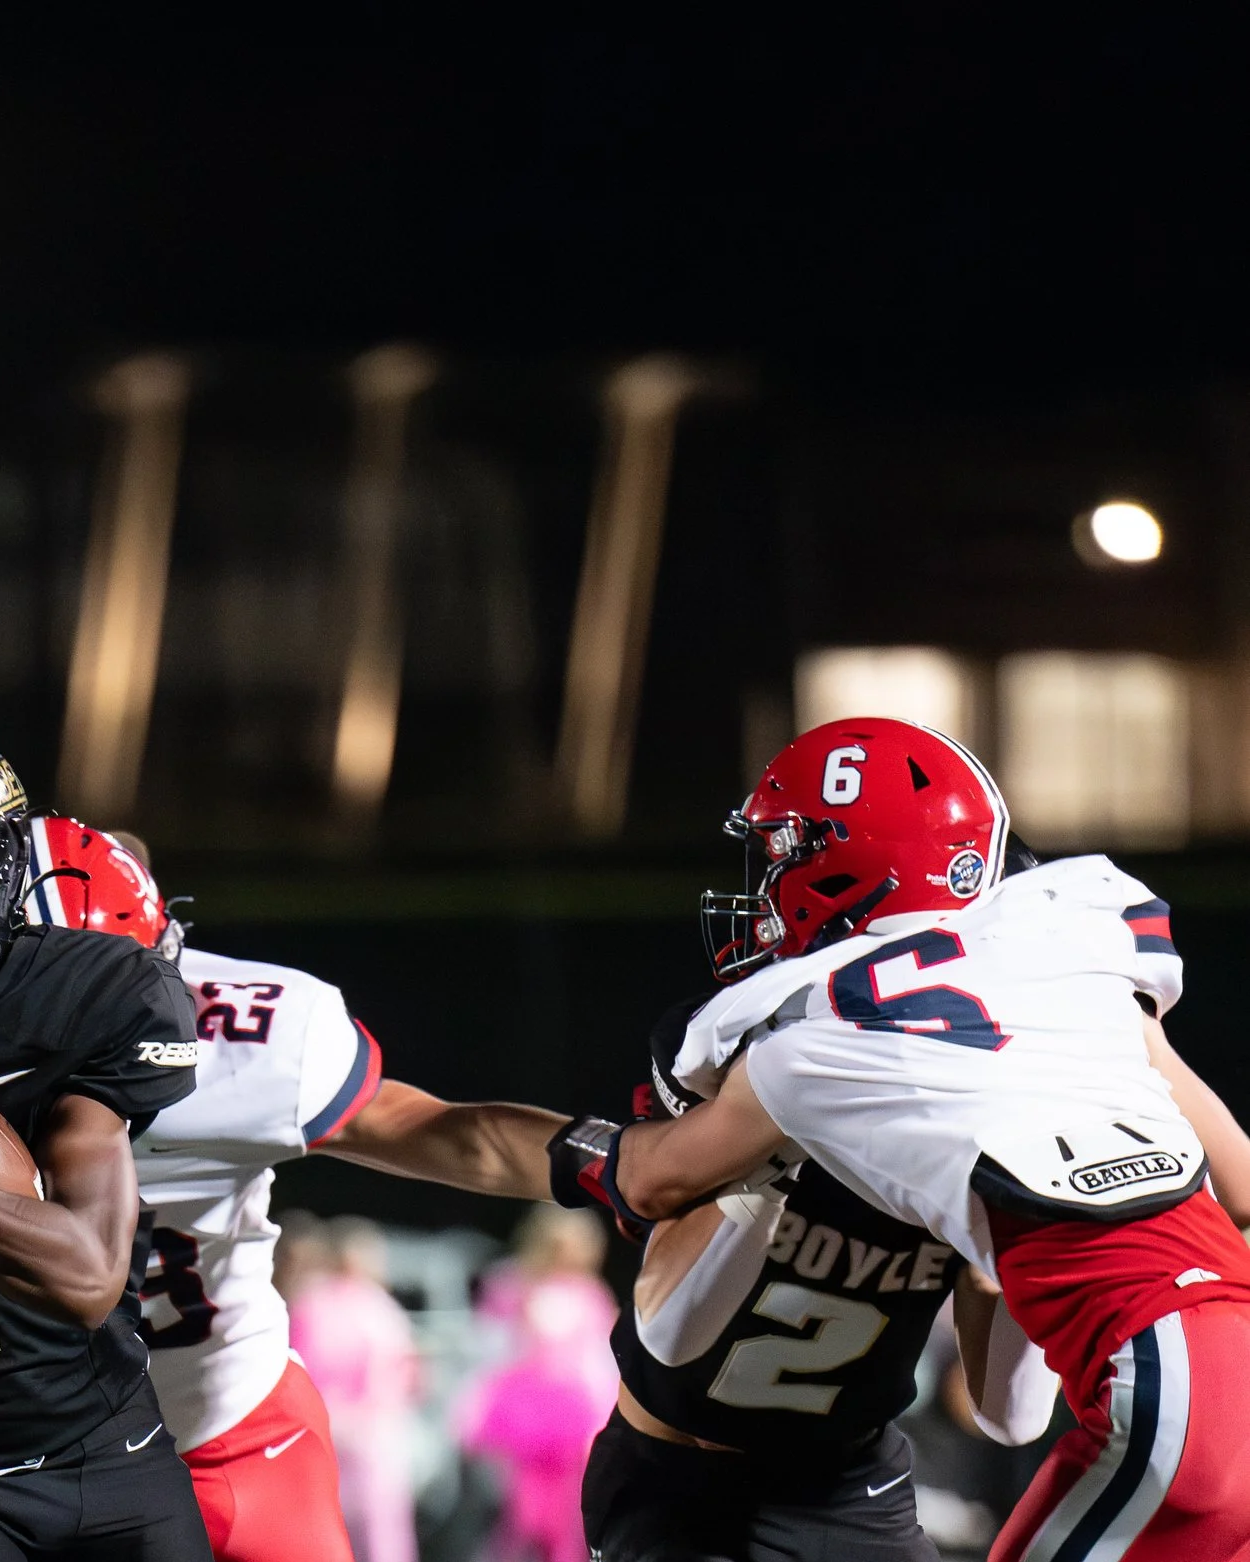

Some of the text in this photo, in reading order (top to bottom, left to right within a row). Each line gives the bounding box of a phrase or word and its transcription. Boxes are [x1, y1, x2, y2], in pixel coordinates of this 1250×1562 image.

[820, 745, 868, 807] 6
[196, 981, 286, 1045] 23
[828, 927, 1014, 1053] 6
[136, 1041, 198, 1068] REBE
[1078, 1156, 1174, 1190] BATTLE
[136, 1226, 221, 1351] 3
[767, 1209, 954, 1294] BOYLE
[706, 1280, 891, 1416] 2
